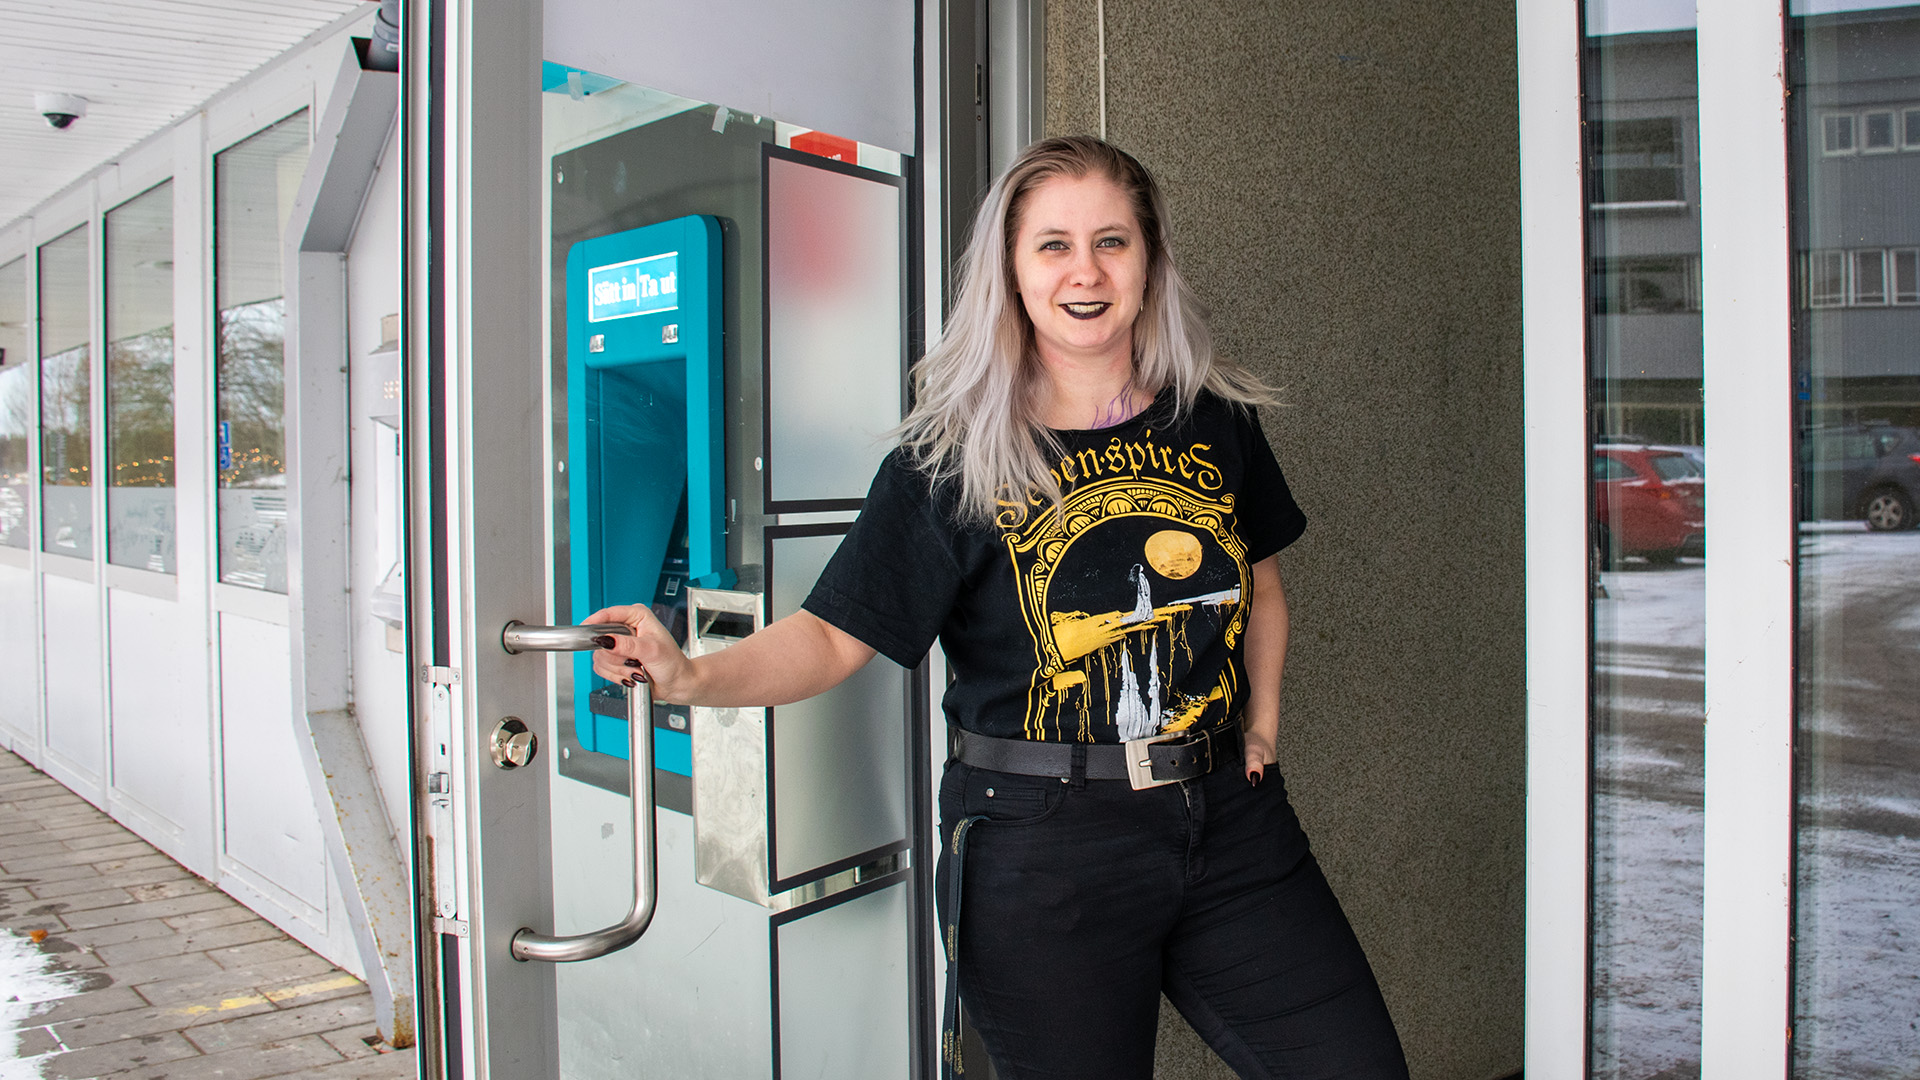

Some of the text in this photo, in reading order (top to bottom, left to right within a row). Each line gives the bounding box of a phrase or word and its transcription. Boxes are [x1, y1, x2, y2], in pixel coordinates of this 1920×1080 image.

[622, 276, 637, 301] in
[639, 273, 659, 298] Ta
[660, 271, 677, 295] ut
